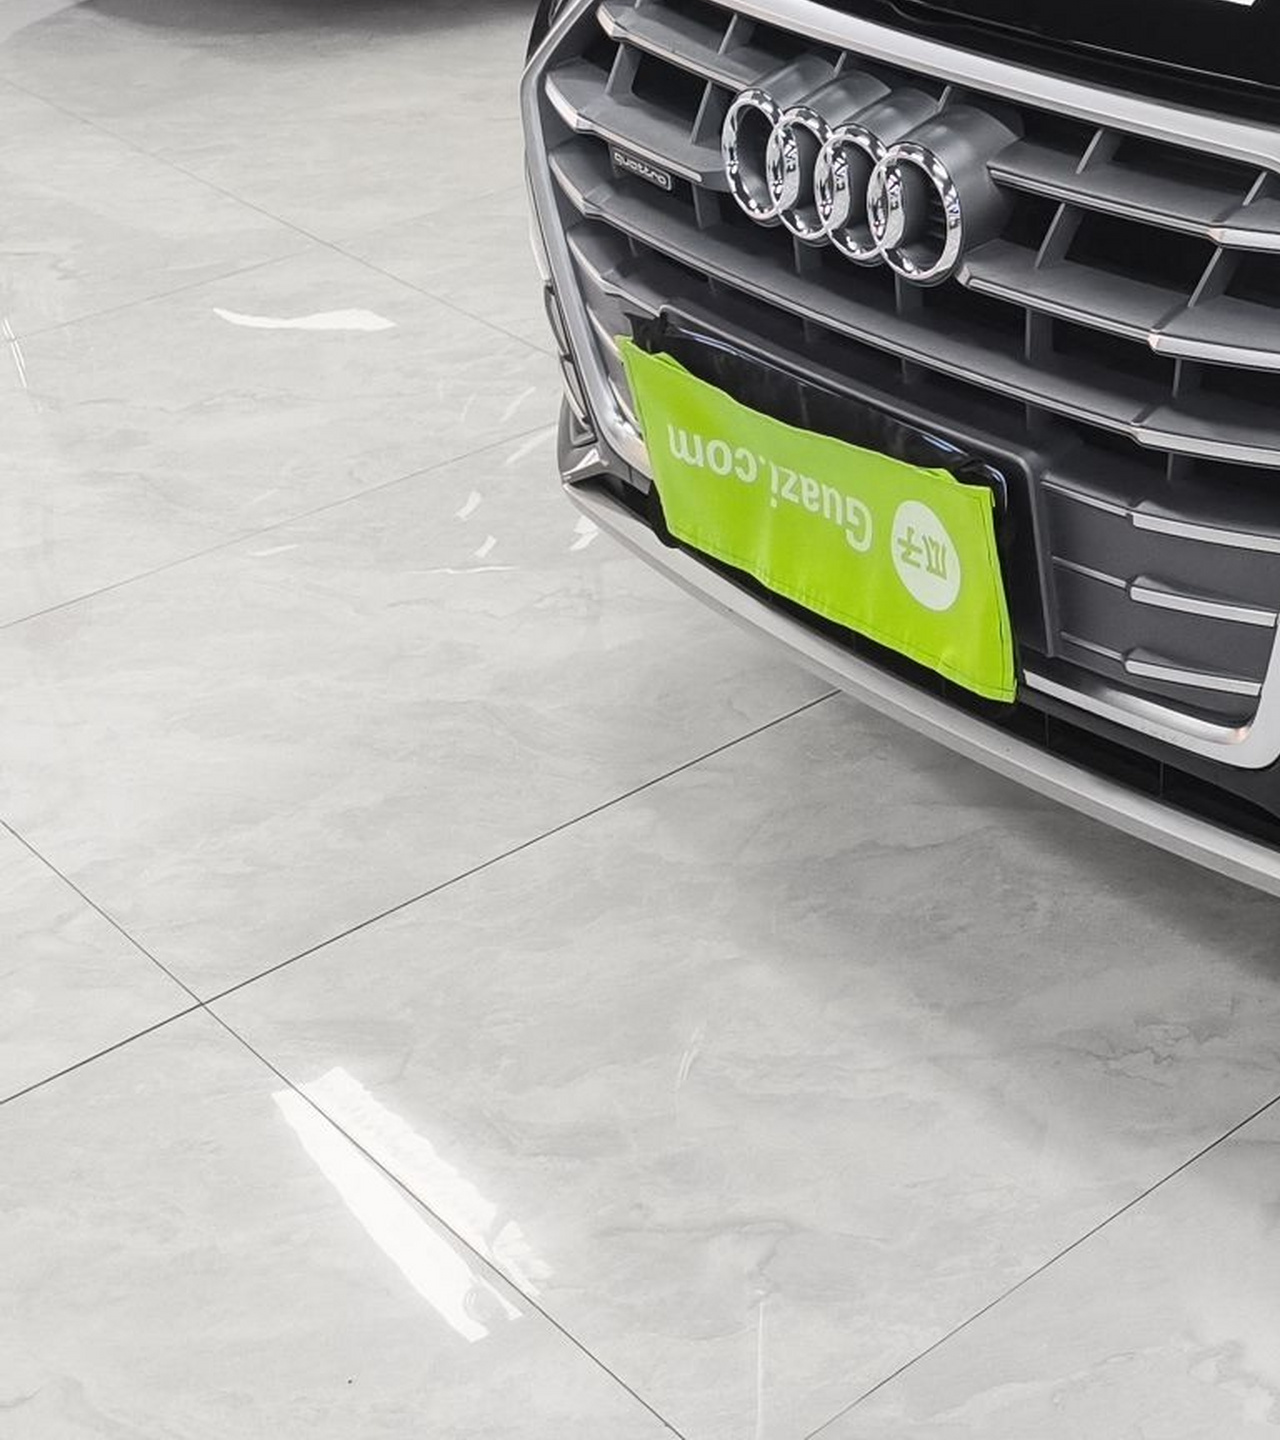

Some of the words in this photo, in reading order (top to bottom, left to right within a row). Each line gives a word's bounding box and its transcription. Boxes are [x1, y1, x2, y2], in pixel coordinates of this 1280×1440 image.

[614, 152, 667, 185] quattro
[667, 423, 874, 552] Guazi.com
[897, 526, 948, 581] 瓜子
